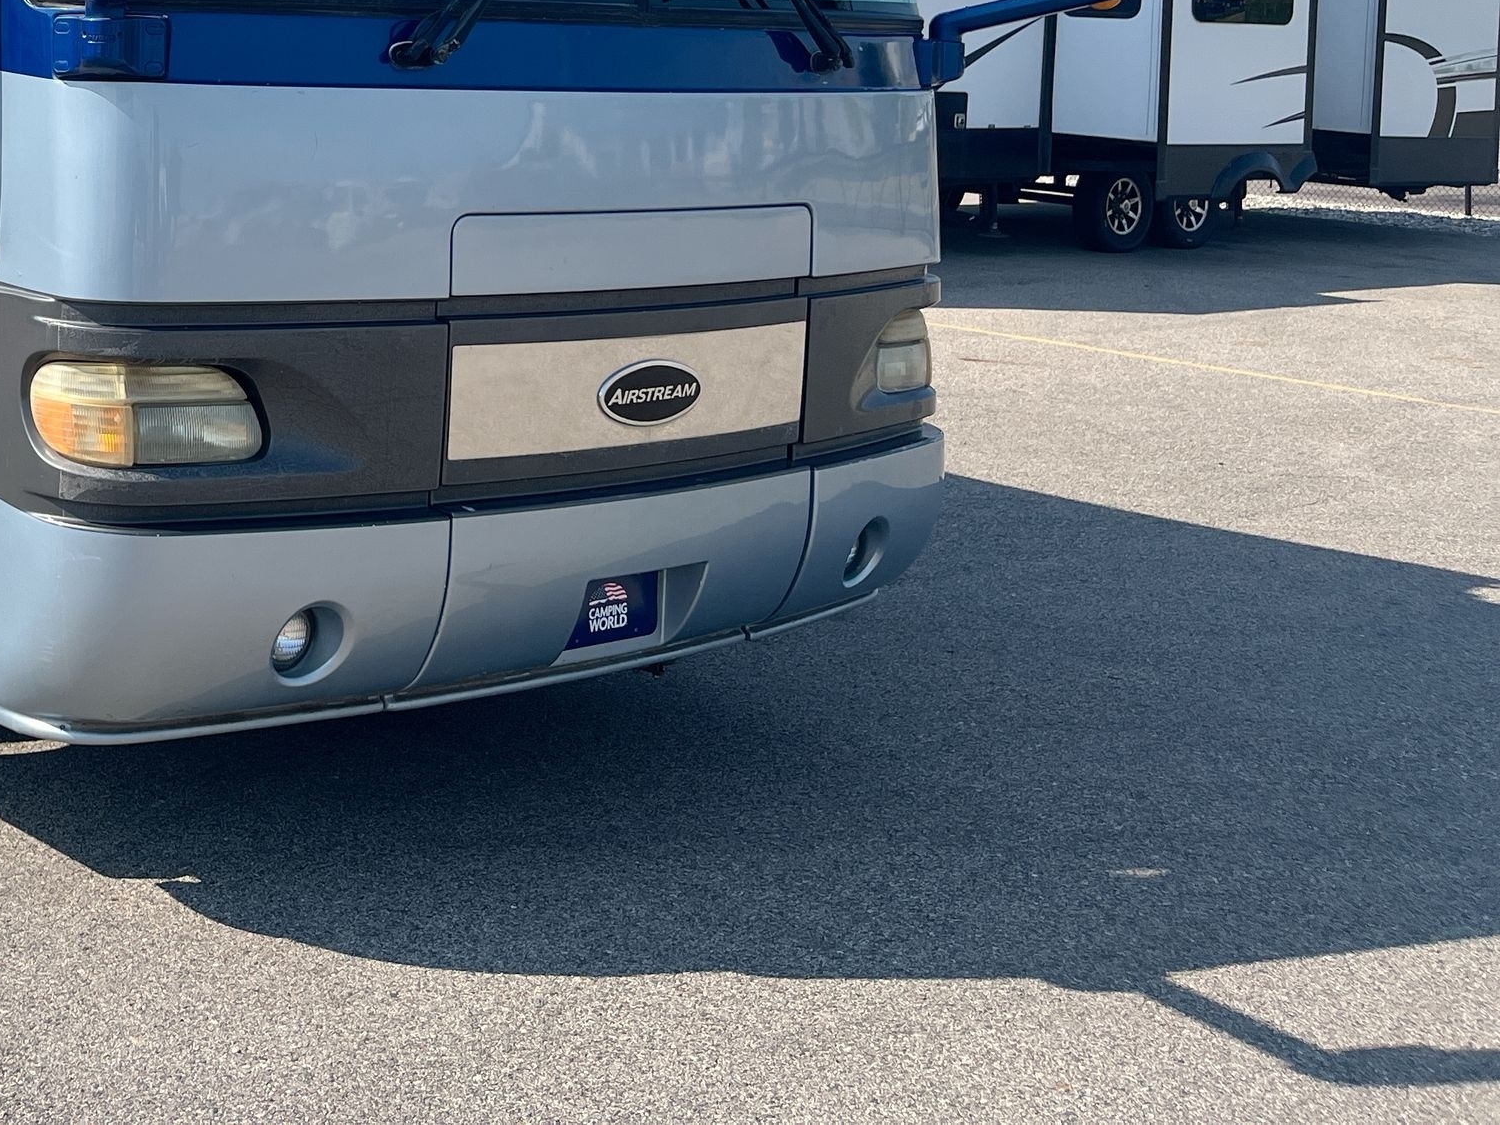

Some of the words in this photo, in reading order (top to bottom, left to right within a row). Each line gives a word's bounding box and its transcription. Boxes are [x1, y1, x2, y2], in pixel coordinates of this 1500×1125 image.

[607, 382, 698, 407] AIRSTREAM
[588, 602, 628, 620] CAMPING
[588, 614, 628, 633] WORLD
